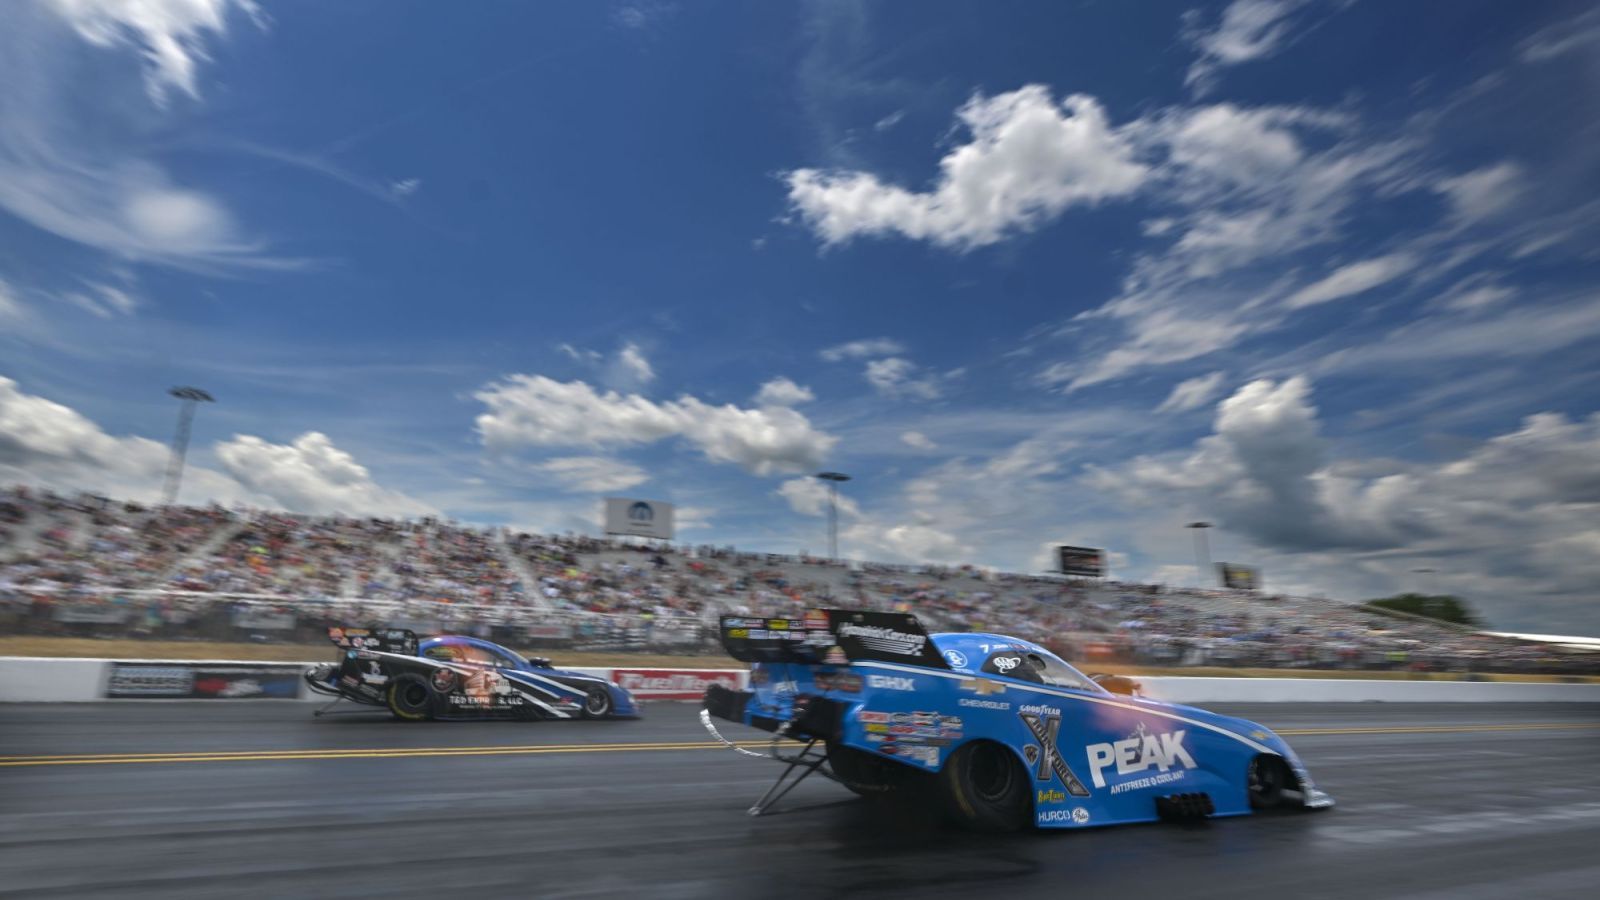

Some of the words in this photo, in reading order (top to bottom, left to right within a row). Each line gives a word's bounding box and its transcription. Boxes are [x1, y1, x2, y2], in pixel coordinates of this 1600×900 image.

[866, 675, 916, 691] GHX
[958, 698, 1010, 710] CHEVROLET
[1019, 704, 1061, 716] GOODYEAR
[1086, 730, 1199, 789] PEAK
[1110, 778, 1150, 795] ANTIFREEZE
[1157, 770, 1185, 785] COOLANT
[1038, 810, 1071, 822] HURCO
